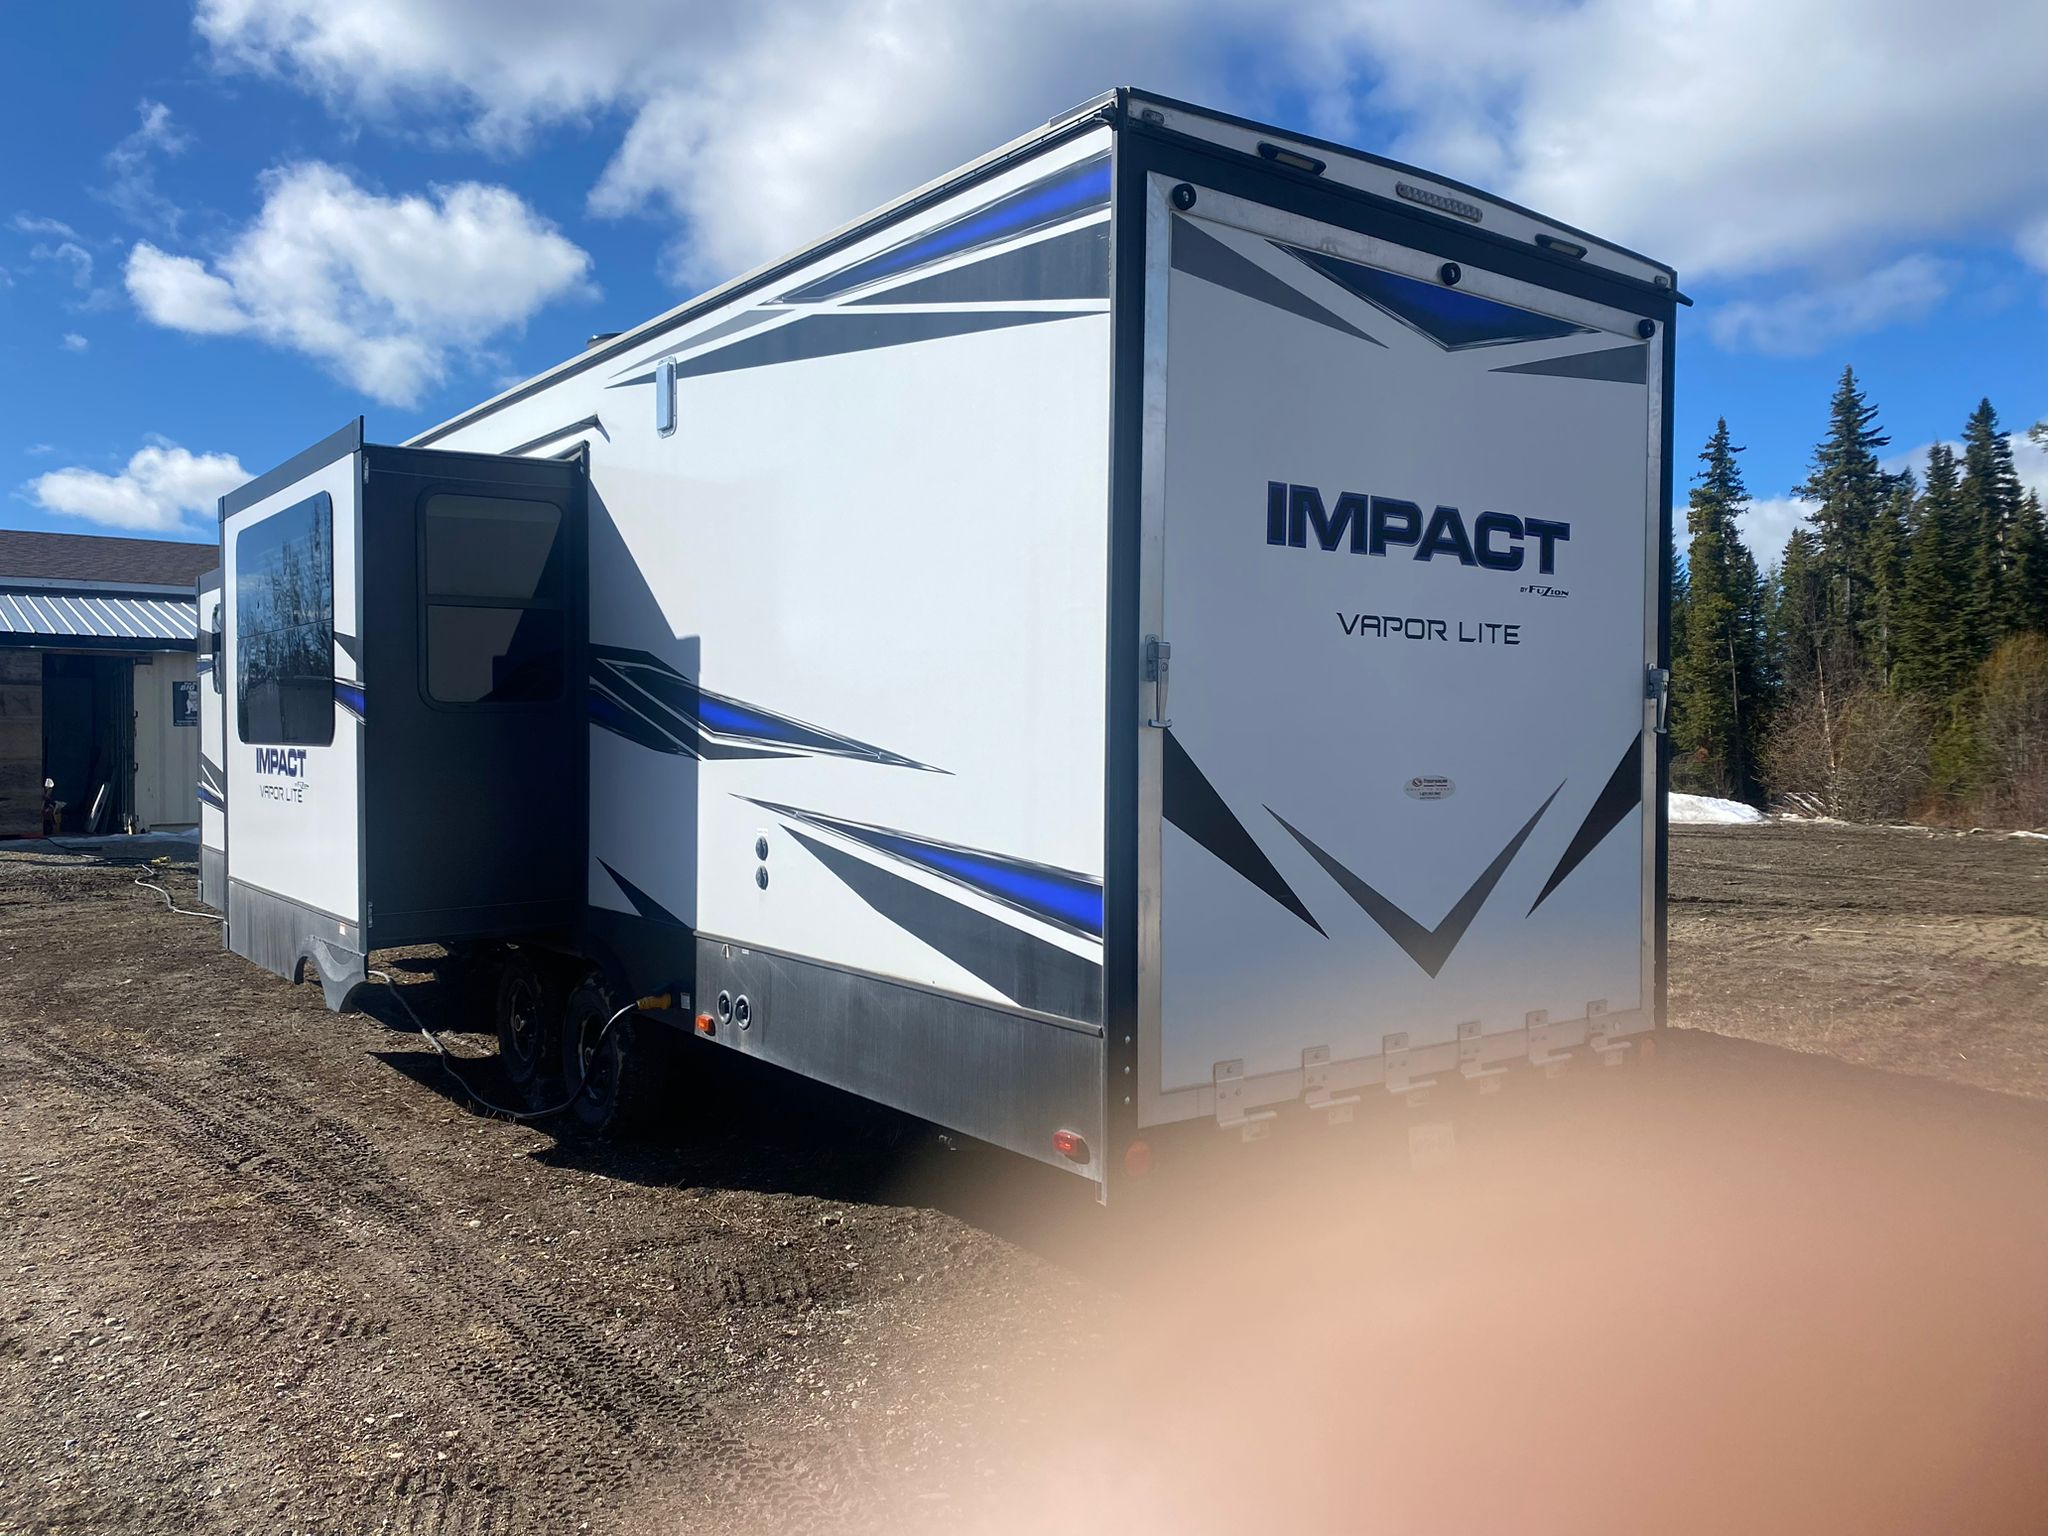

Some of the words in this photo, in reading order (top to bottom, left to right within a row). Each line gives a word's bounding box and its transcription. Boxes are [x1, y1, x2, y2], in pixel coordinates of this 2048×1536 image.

[1266, 480, 1570, 575] IMPACT
[1336, 612, 1448, 641] VAPOR
[1458, 621, 1521, 645] LITE
[256, 748, 306, 778] IMPACT
[259, 785, 284, 801] VAPOR
[286, 788, 302, 803] LITE
